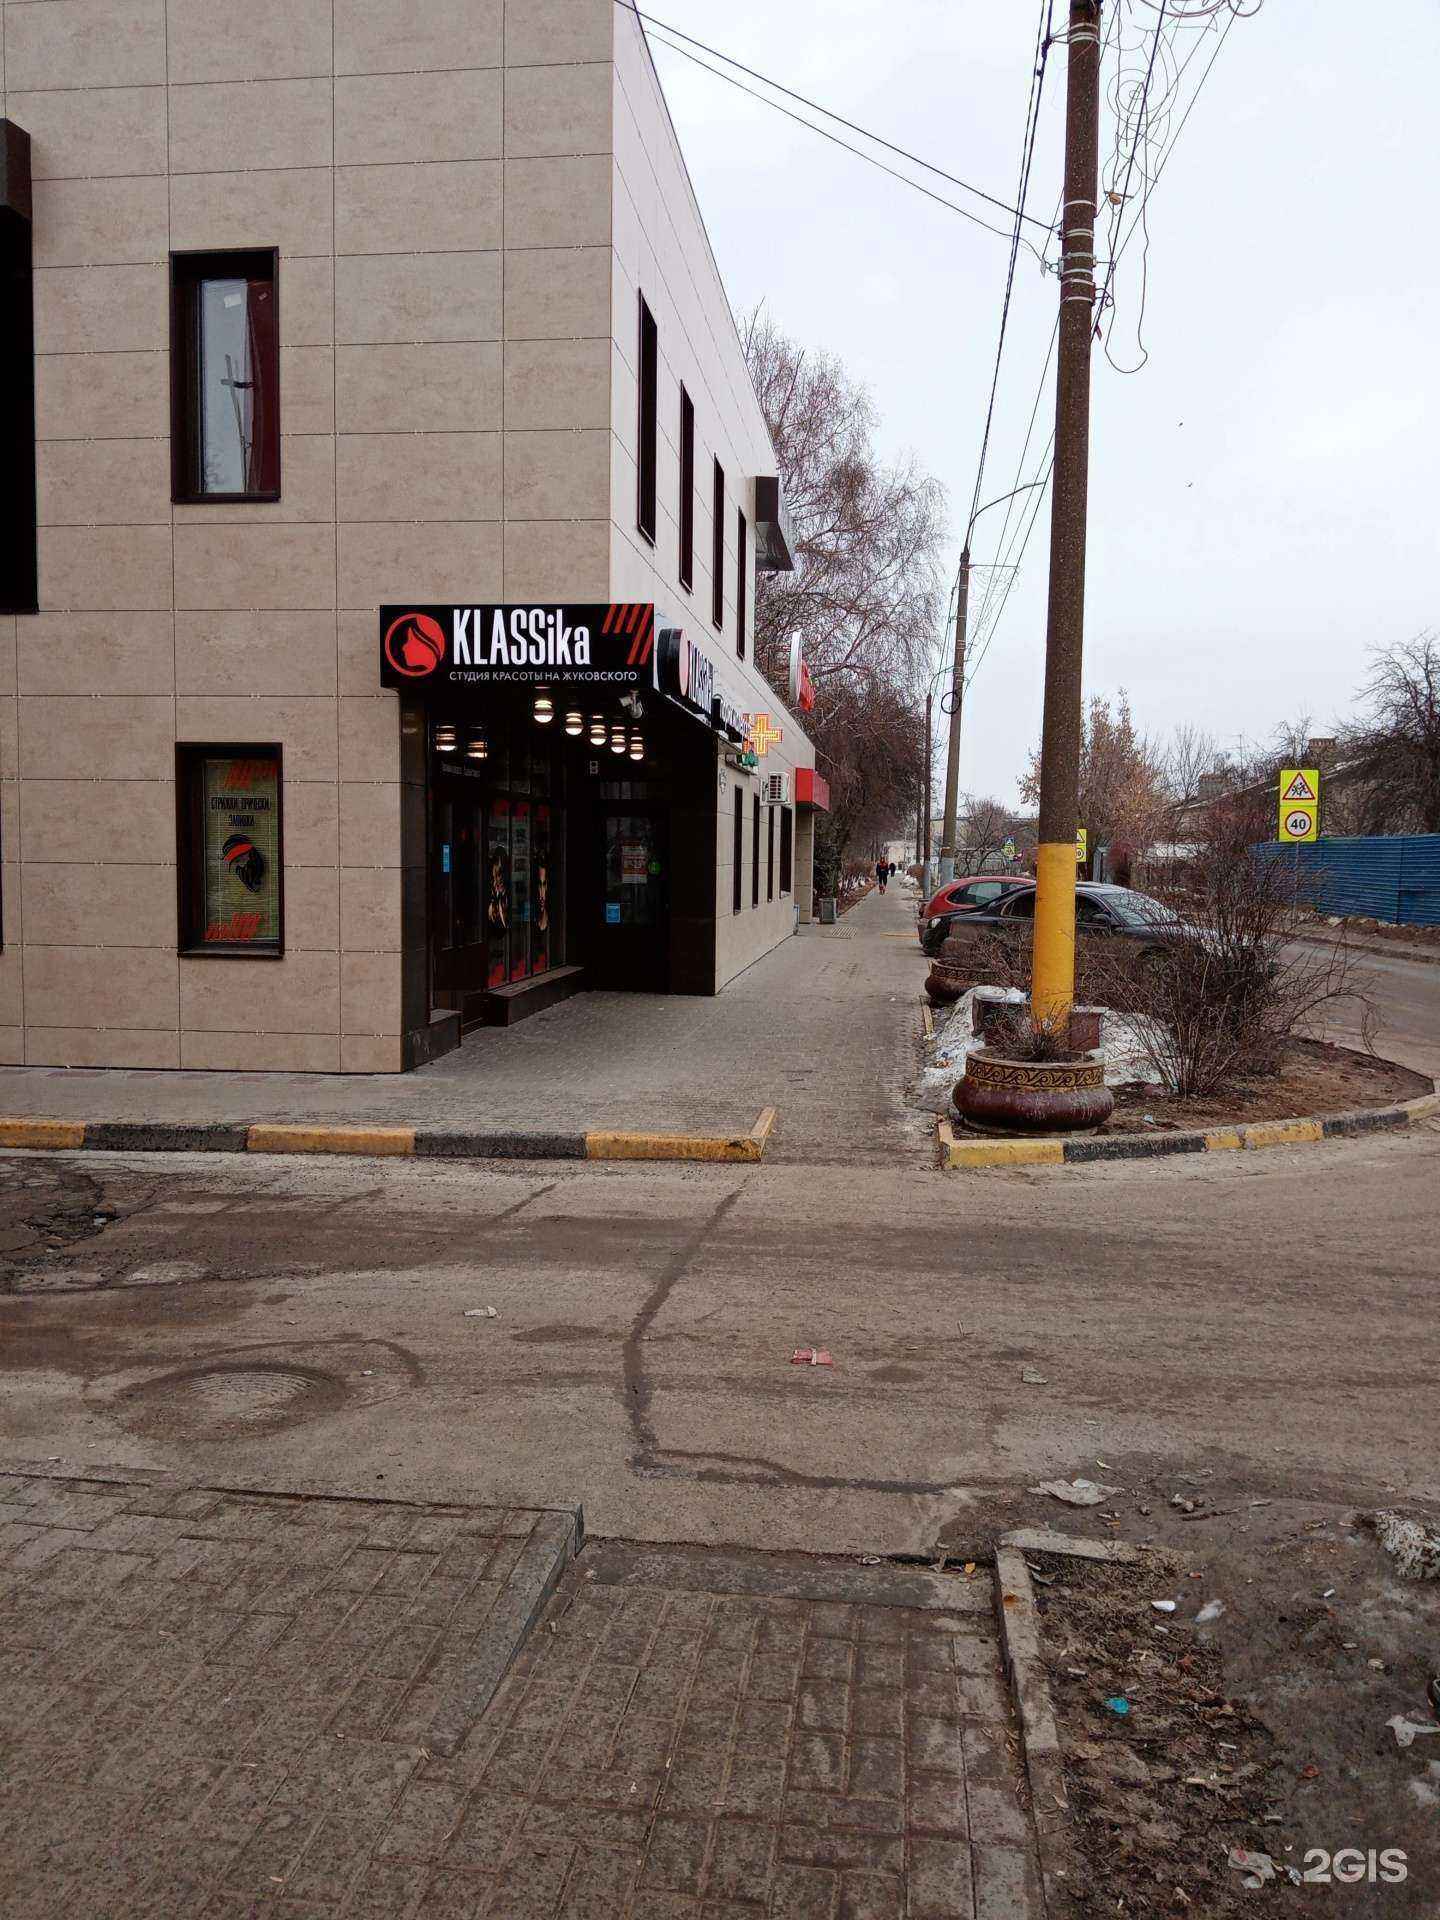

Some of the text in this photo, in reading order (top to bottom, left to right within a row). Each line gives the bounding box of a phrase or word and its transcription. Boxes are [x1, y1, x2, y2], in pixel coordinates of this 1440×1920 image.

[453, 608, 592, 665] KLASSika
[449, 671, 637, 681] СТУДИЯ КРАСОТЫ НА ЖУКОВСКОГО
[1290, 818, 1306, 829] 40
